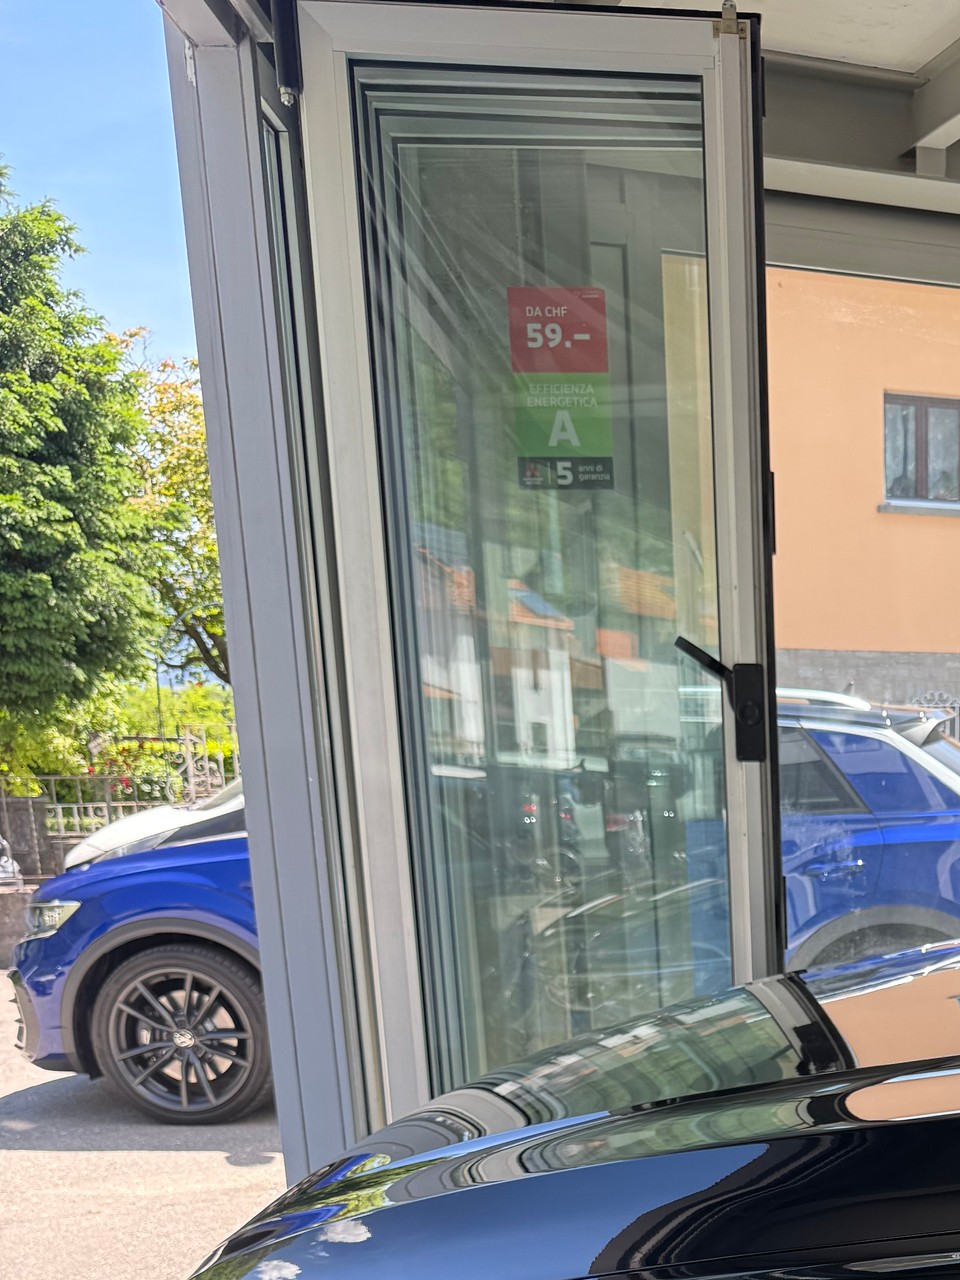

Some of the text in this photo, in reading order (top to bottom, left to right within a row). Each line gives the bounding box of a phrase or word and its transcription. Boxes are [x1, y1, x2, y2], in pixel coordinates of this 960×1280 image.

[525, 306, 568, 318] DA CHF
[528, 383, 595, 395] EFFICIENZA
[527, 396, 599, 408] ENERGETICA
[548, 410, 581, 448] A
[556, 461, 574, 486] 5
[578, 473, 611, 482] garanzia
